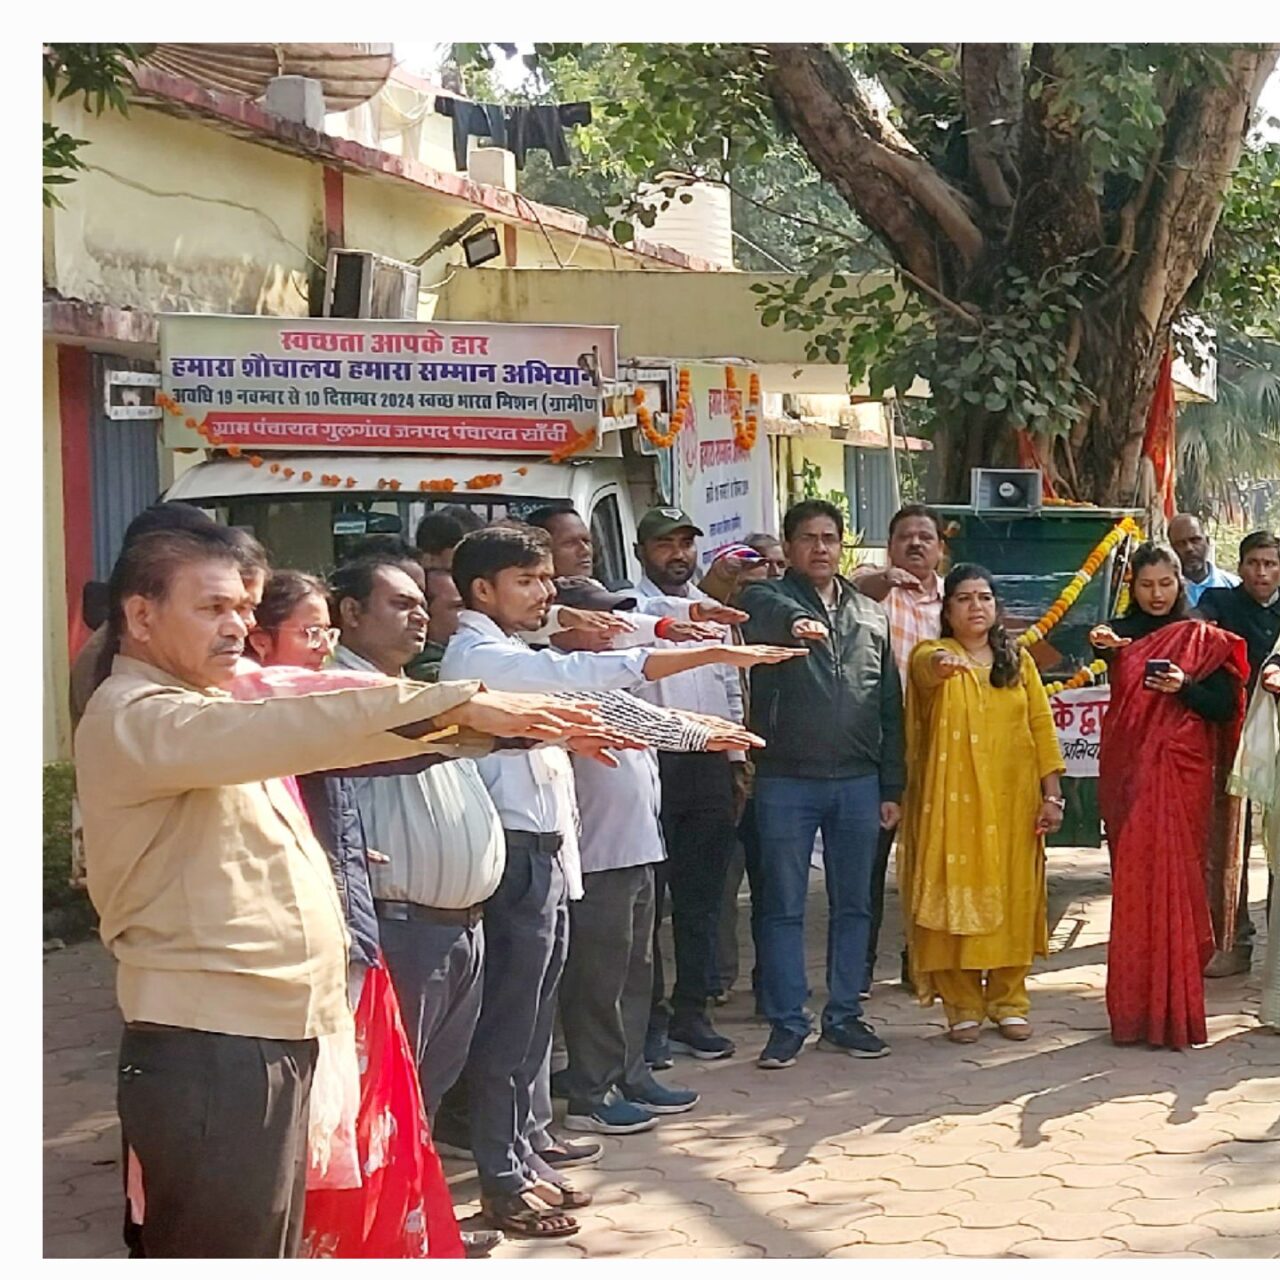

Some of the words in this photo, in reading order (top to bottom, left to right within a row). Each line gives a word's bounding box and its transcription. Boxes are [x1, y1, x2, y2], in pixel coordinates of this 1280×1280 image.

[281, 331, 365, 352] स्वच्छता
[371, 329, 443, 354] आपके
[451, 335, 489, 356] द्वार
[170, 358, 236, 377] हमारा
[242, 353, 342, 379] शौचालय
[348, 360, 412, 381] हमारा
[418, 362, 497, 382] सम्मान
[503, 360, 599, 386] अभियान
[172, 384, 213, 404] अवधि
[218, 389, 233, 405] 19
[237, 389, 285, 405] नवम्बर
[287, 386, 301, 405] से
[305, 391, 320, 406] 10
[322, 387, 376, 407] दिसम्बर
[380, 393, 414, 408] 2024
[418, 393, 454, 409] स्वच्छ
[457, 394, 492, 410] भारत
[496, 391, 537, 411] मिशन
[212, 421, 250, 436] ग्राम
[253, 417, 318, 437] पंचायत
[394, 424, 450, 440] जनपद
[452, 421, 517, 441] पंचायत
[1051, 697, 1074, 731] के
[1076, 701, 1108, 736] द्वा
